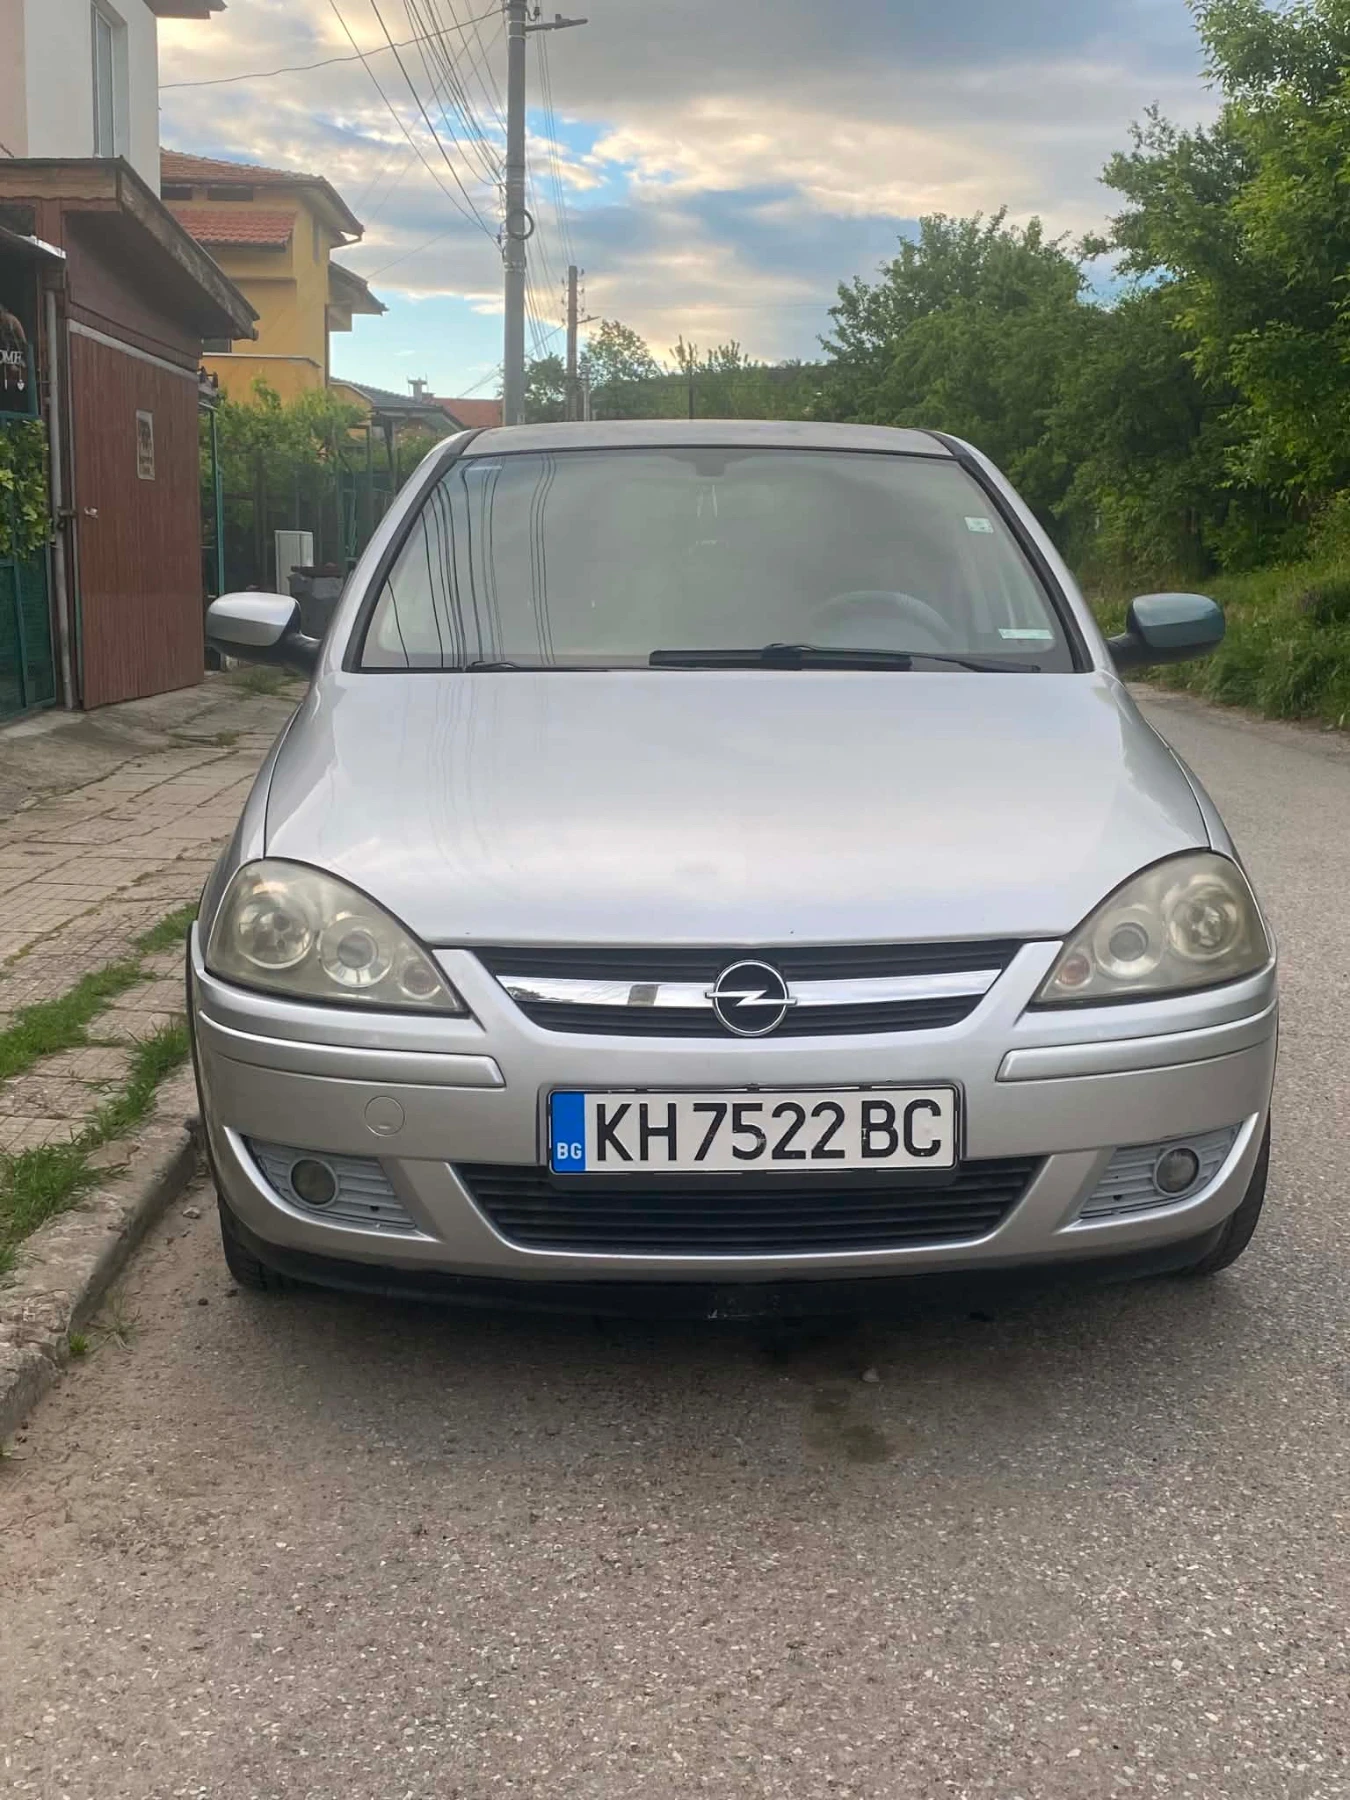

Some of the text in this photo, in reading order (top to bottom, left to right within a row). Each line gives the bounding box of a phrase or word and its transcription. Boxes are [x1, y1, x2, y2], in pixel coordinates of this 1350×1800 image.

[596, 1099, 942, 1162] KH 7522 BC
[556, 1142, 583, 1160] BG
